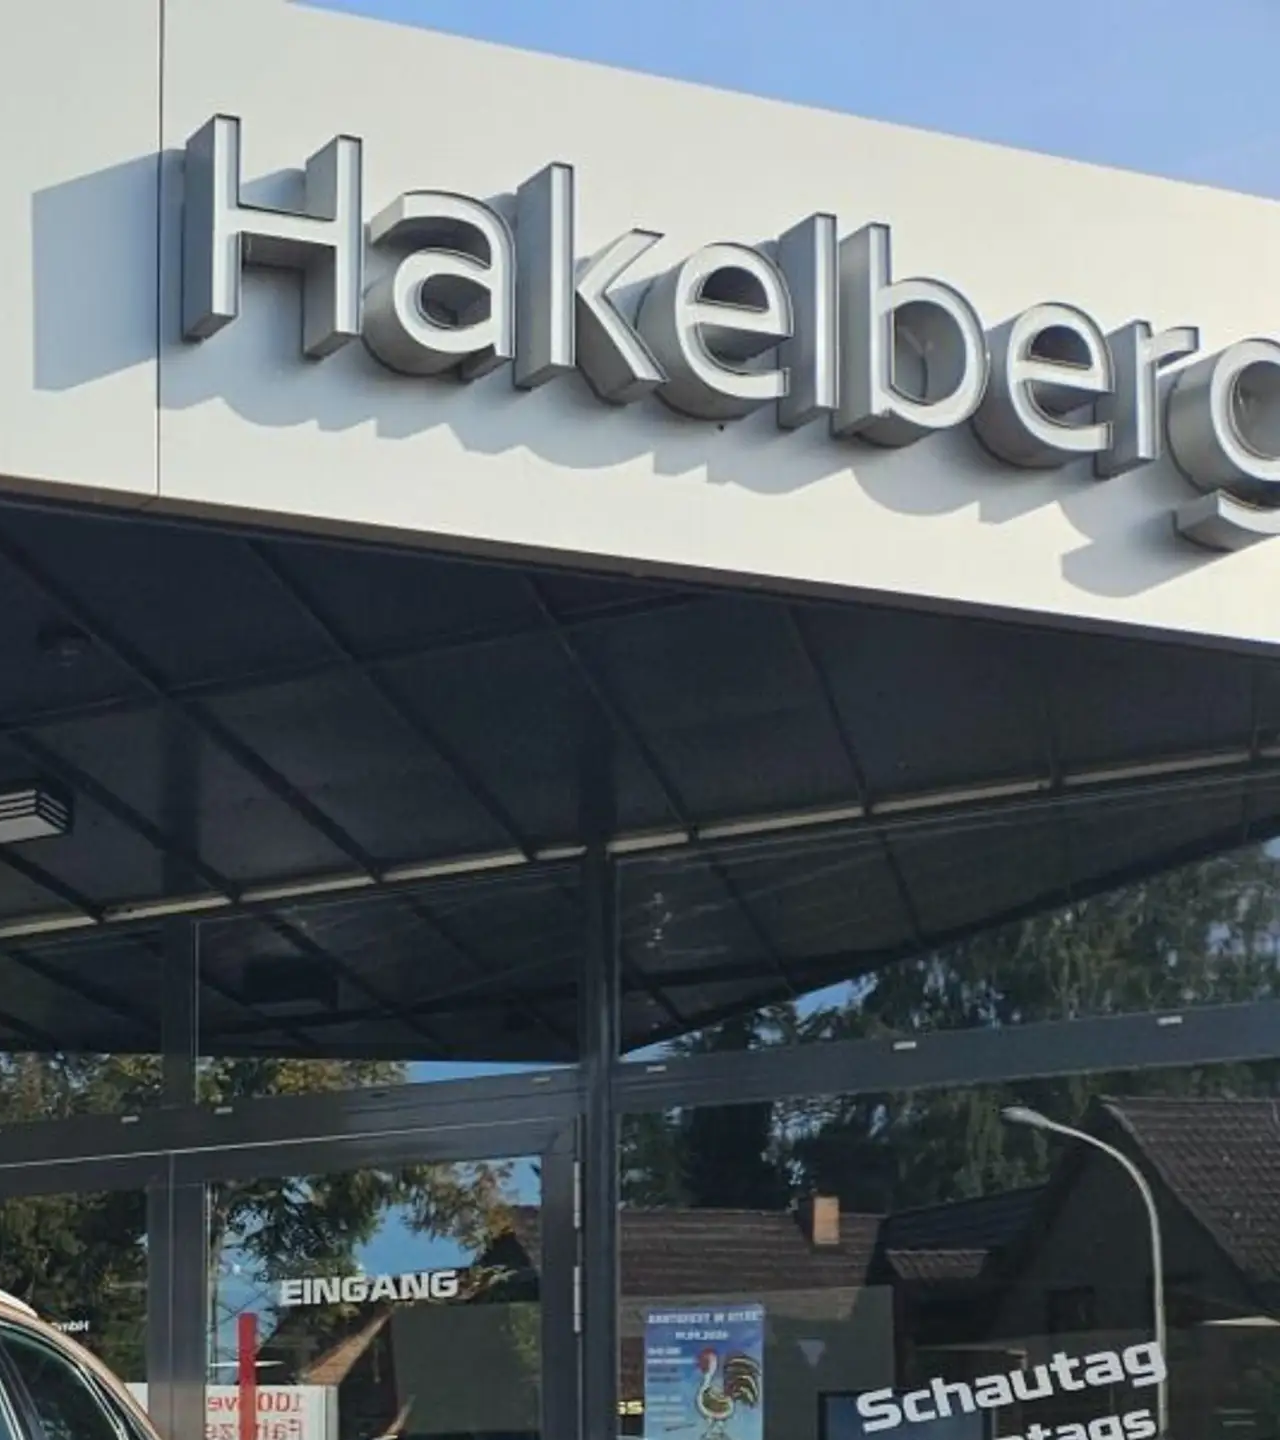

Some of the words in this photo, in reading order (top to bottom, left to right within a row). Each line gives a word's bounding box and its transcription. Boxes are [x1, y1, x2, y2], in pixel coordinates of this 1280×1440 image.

[182, 113, 1280, 553] Hakelberg
[279, 1270, 459, 1307] EINGANG
[856, 1341, 1167, 1433] Schautag
